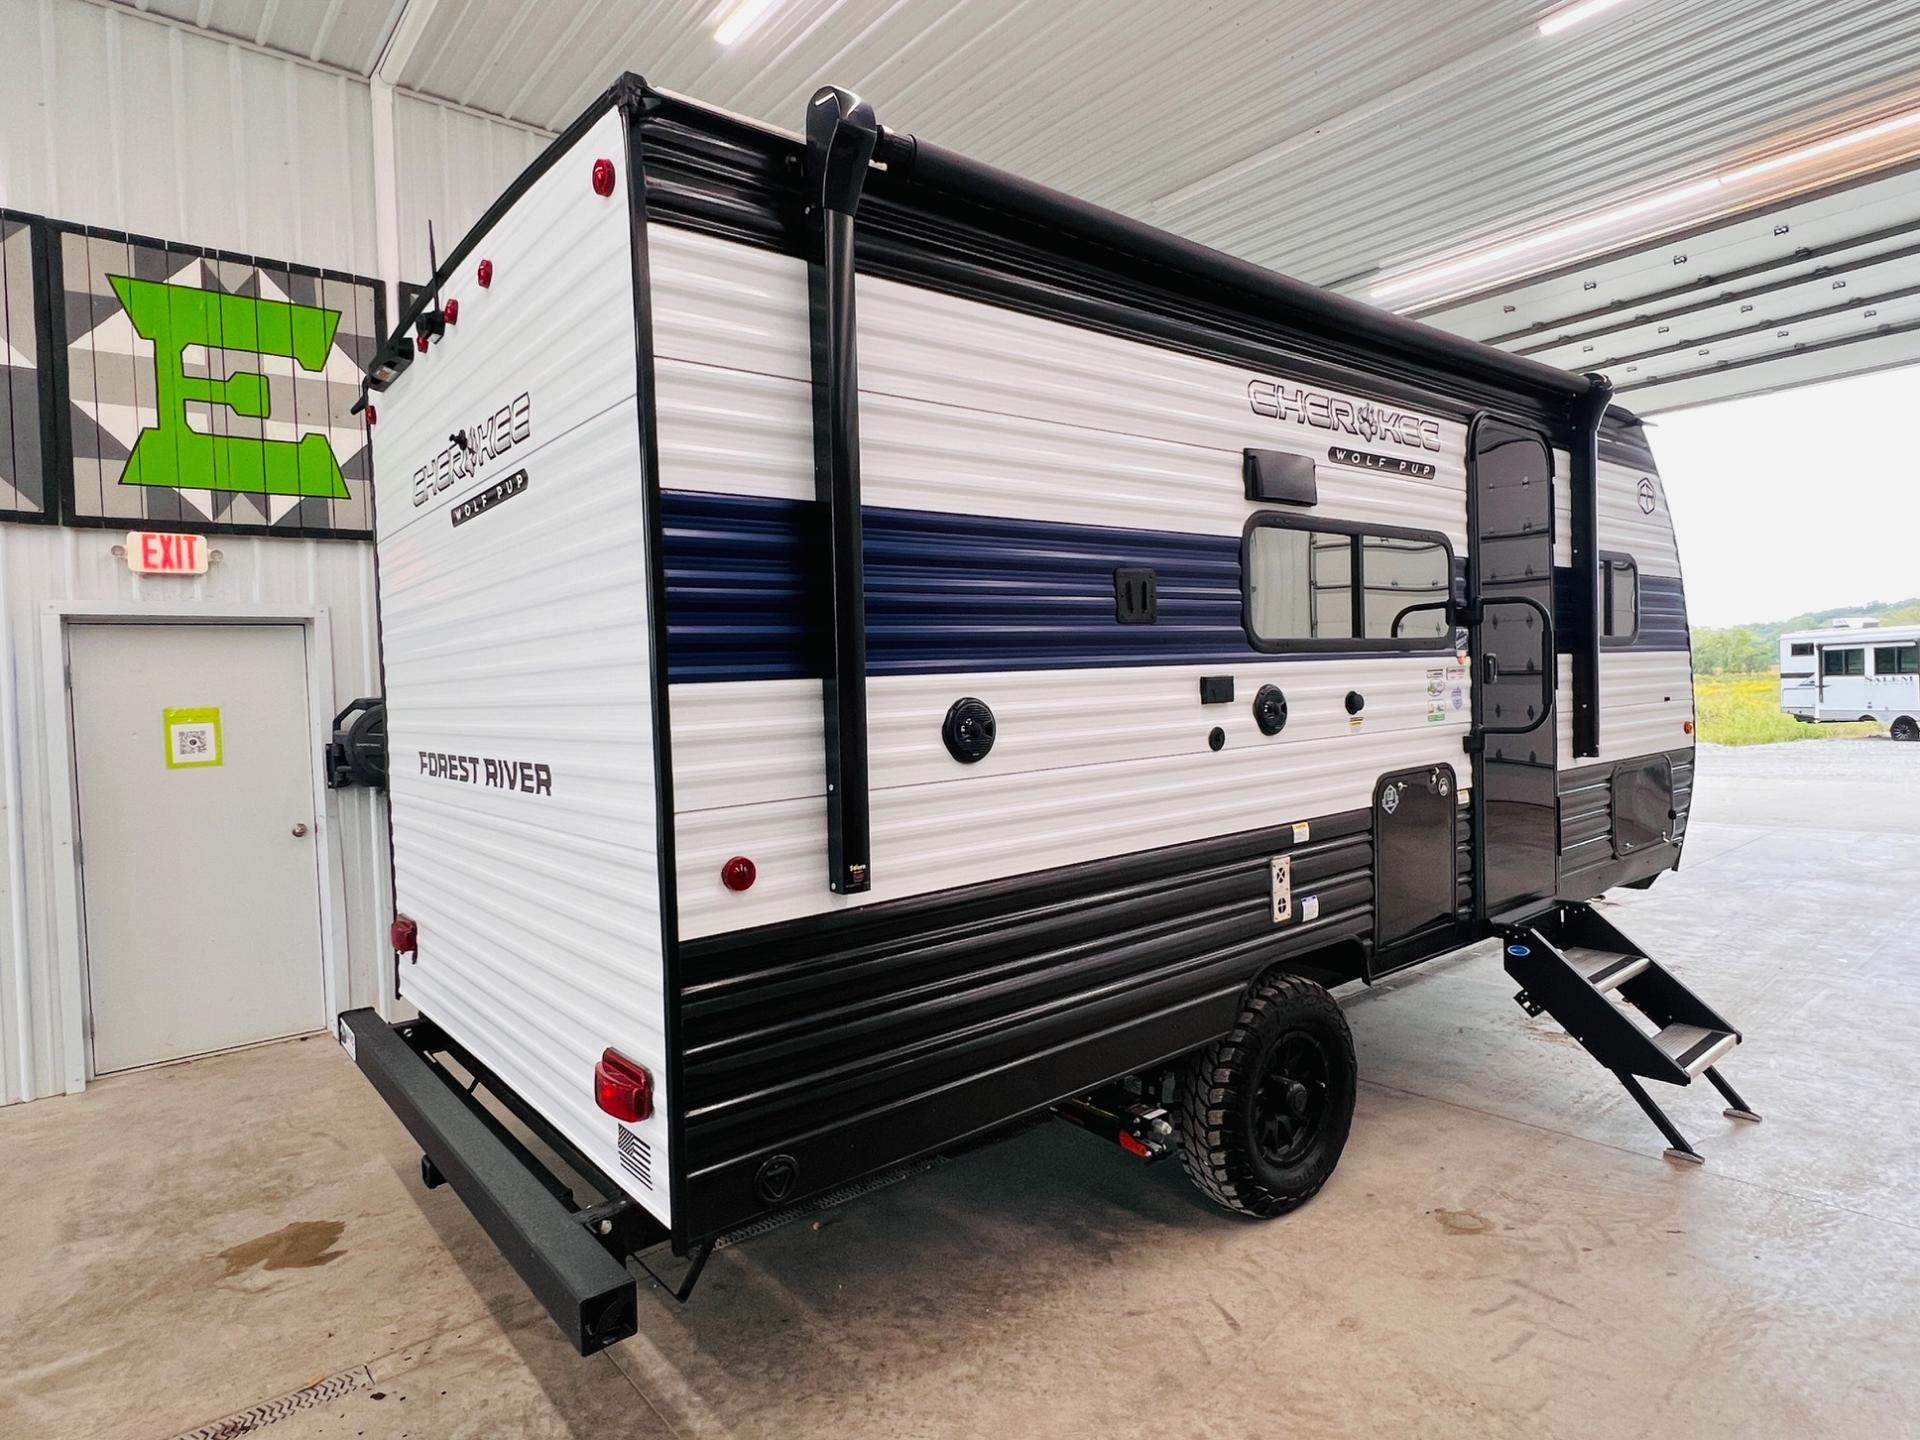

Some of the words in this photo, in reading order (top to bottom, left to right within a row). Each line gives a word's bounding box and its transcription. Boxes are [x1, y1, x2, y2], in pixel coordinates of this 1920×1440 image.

[1247, 379, 1441, 453] CHEROKEE
[1335, 449, 1387, 468] WOLF
[1399, 462, 1431, 476] PUP
[454, 493, 488, 521] WOLF
[495, 473, 524, 500] PUP
[142, 533, 198, 570] EXIT
[418, 751, 480, 785] FOREST
[483, 758, 553, 797] RIVER
